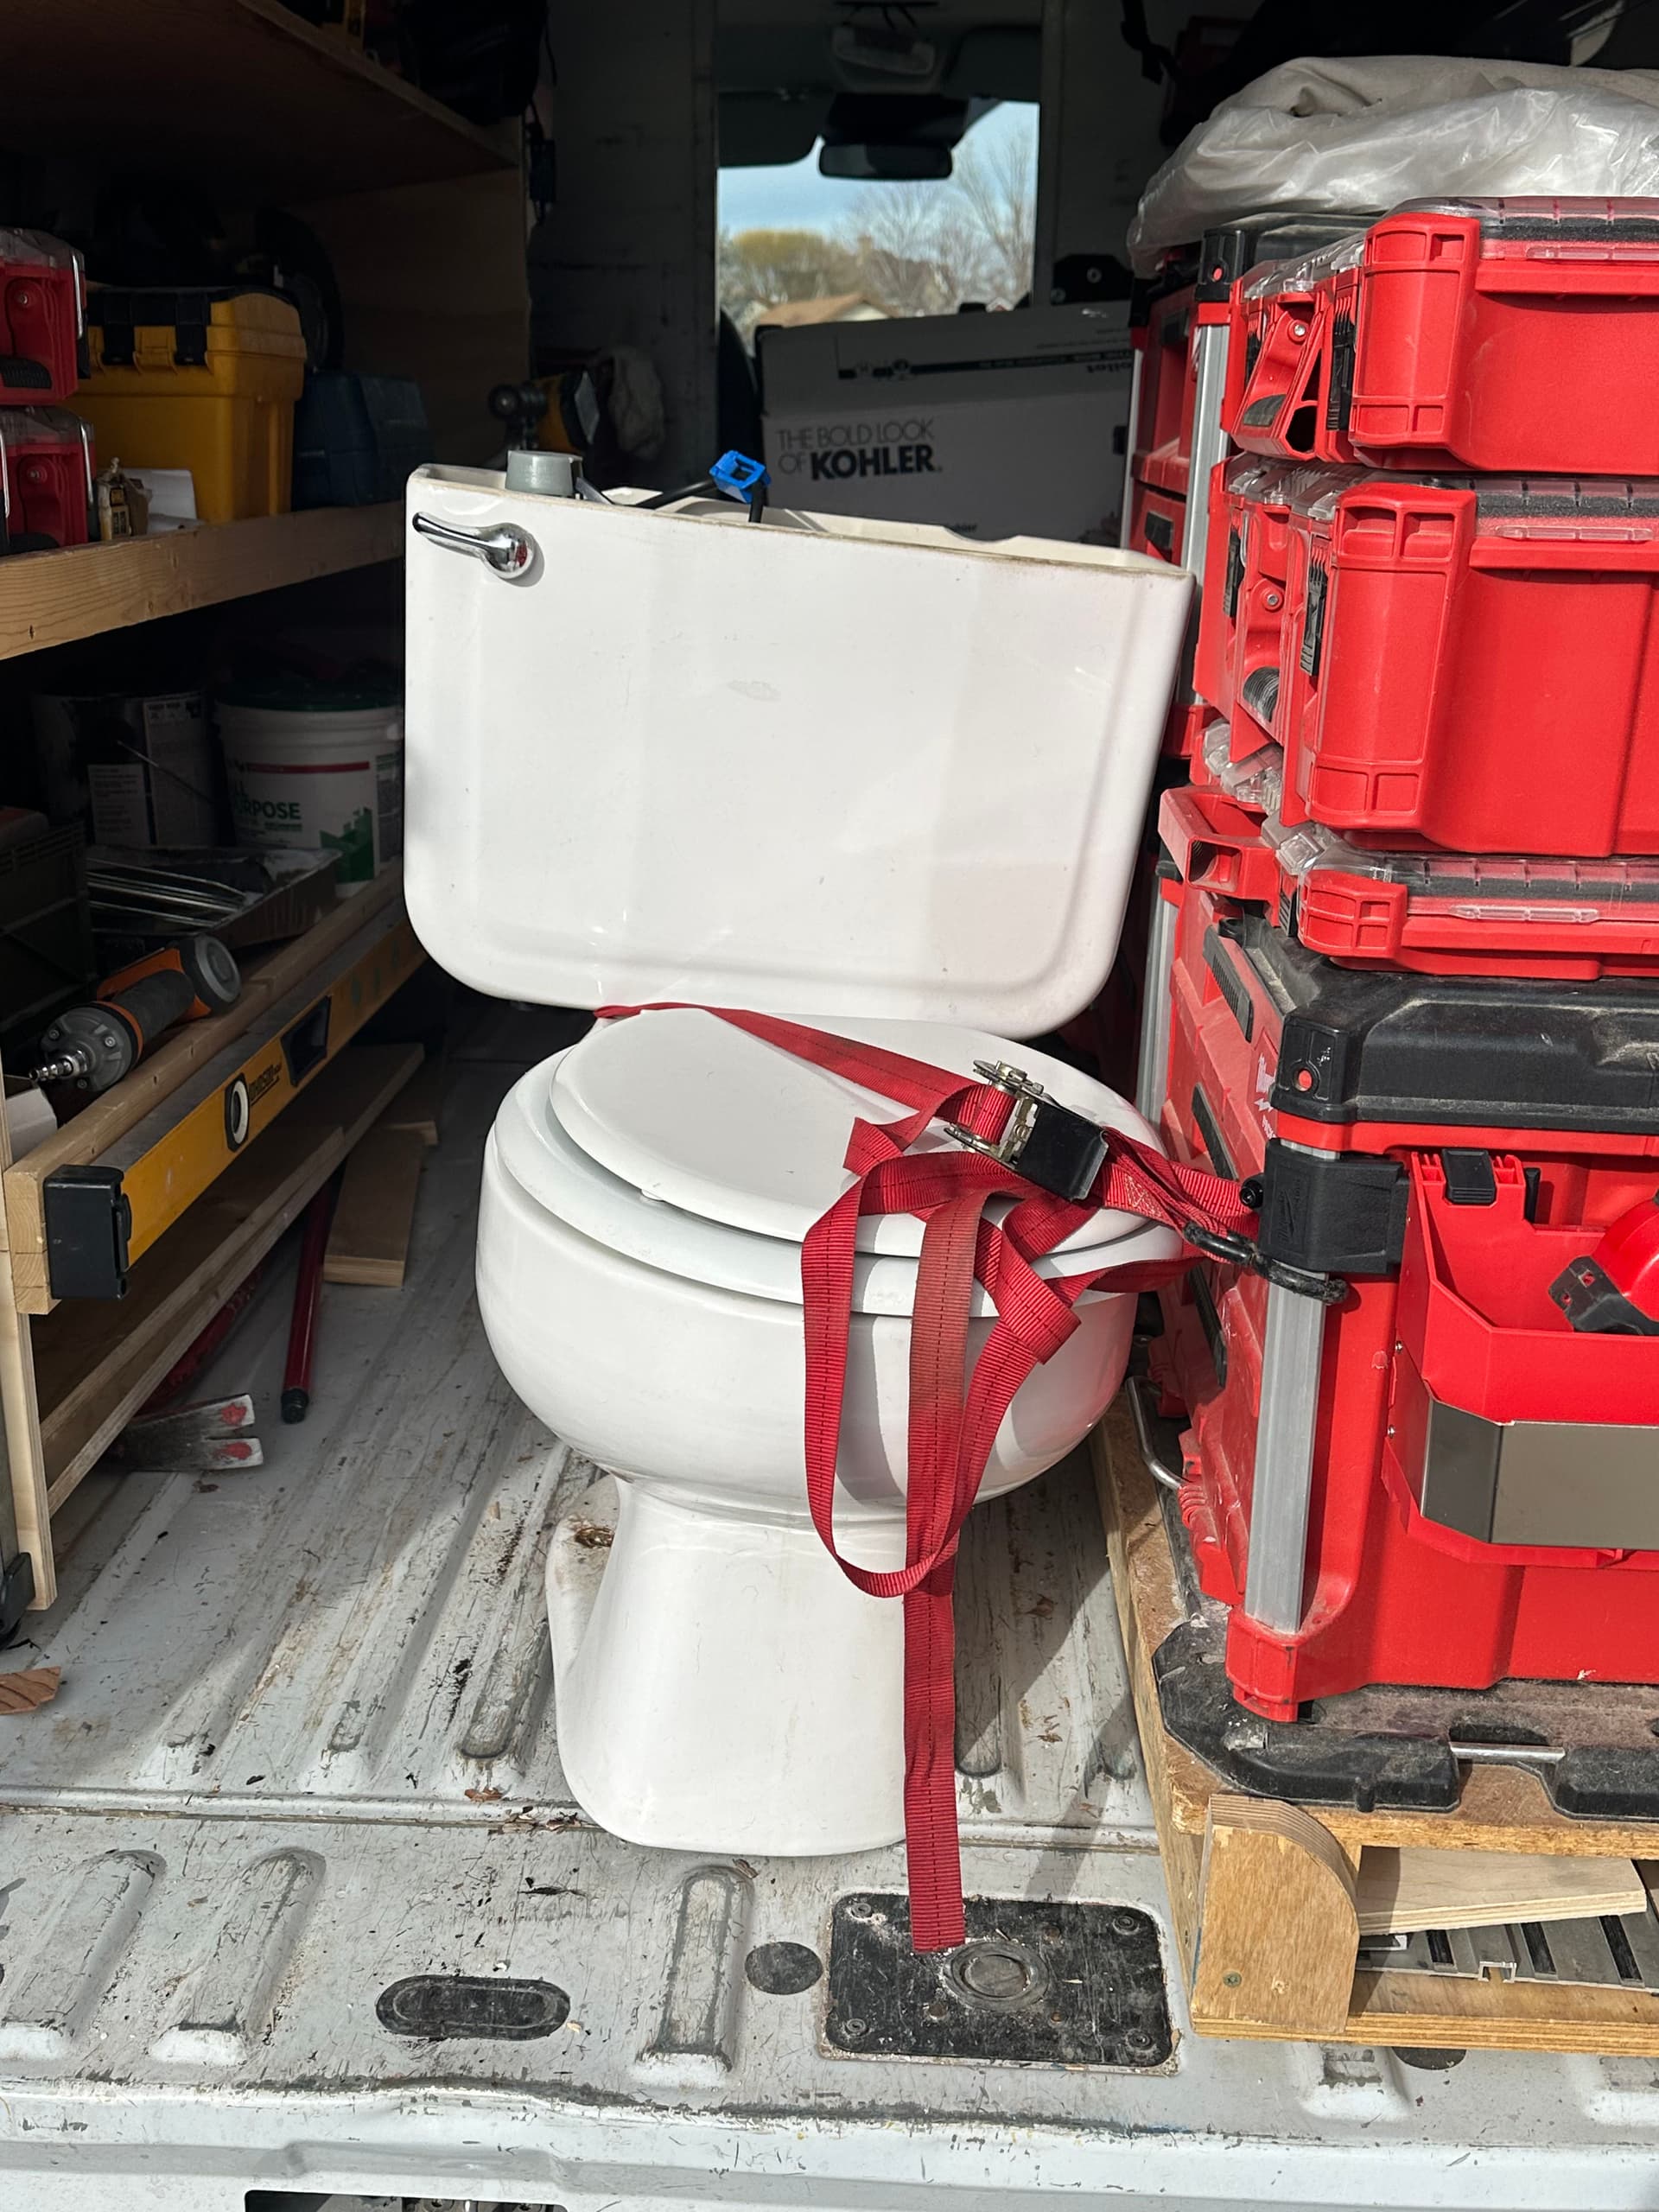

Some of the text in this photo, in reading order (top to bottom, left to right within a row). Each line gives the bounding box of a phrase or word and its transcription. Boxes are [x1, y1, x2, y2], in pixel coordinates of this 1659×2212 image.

[777, 417, 934, 449] THE BOLD LOOK
[779, 443, 935, 480] OF KOHLER
